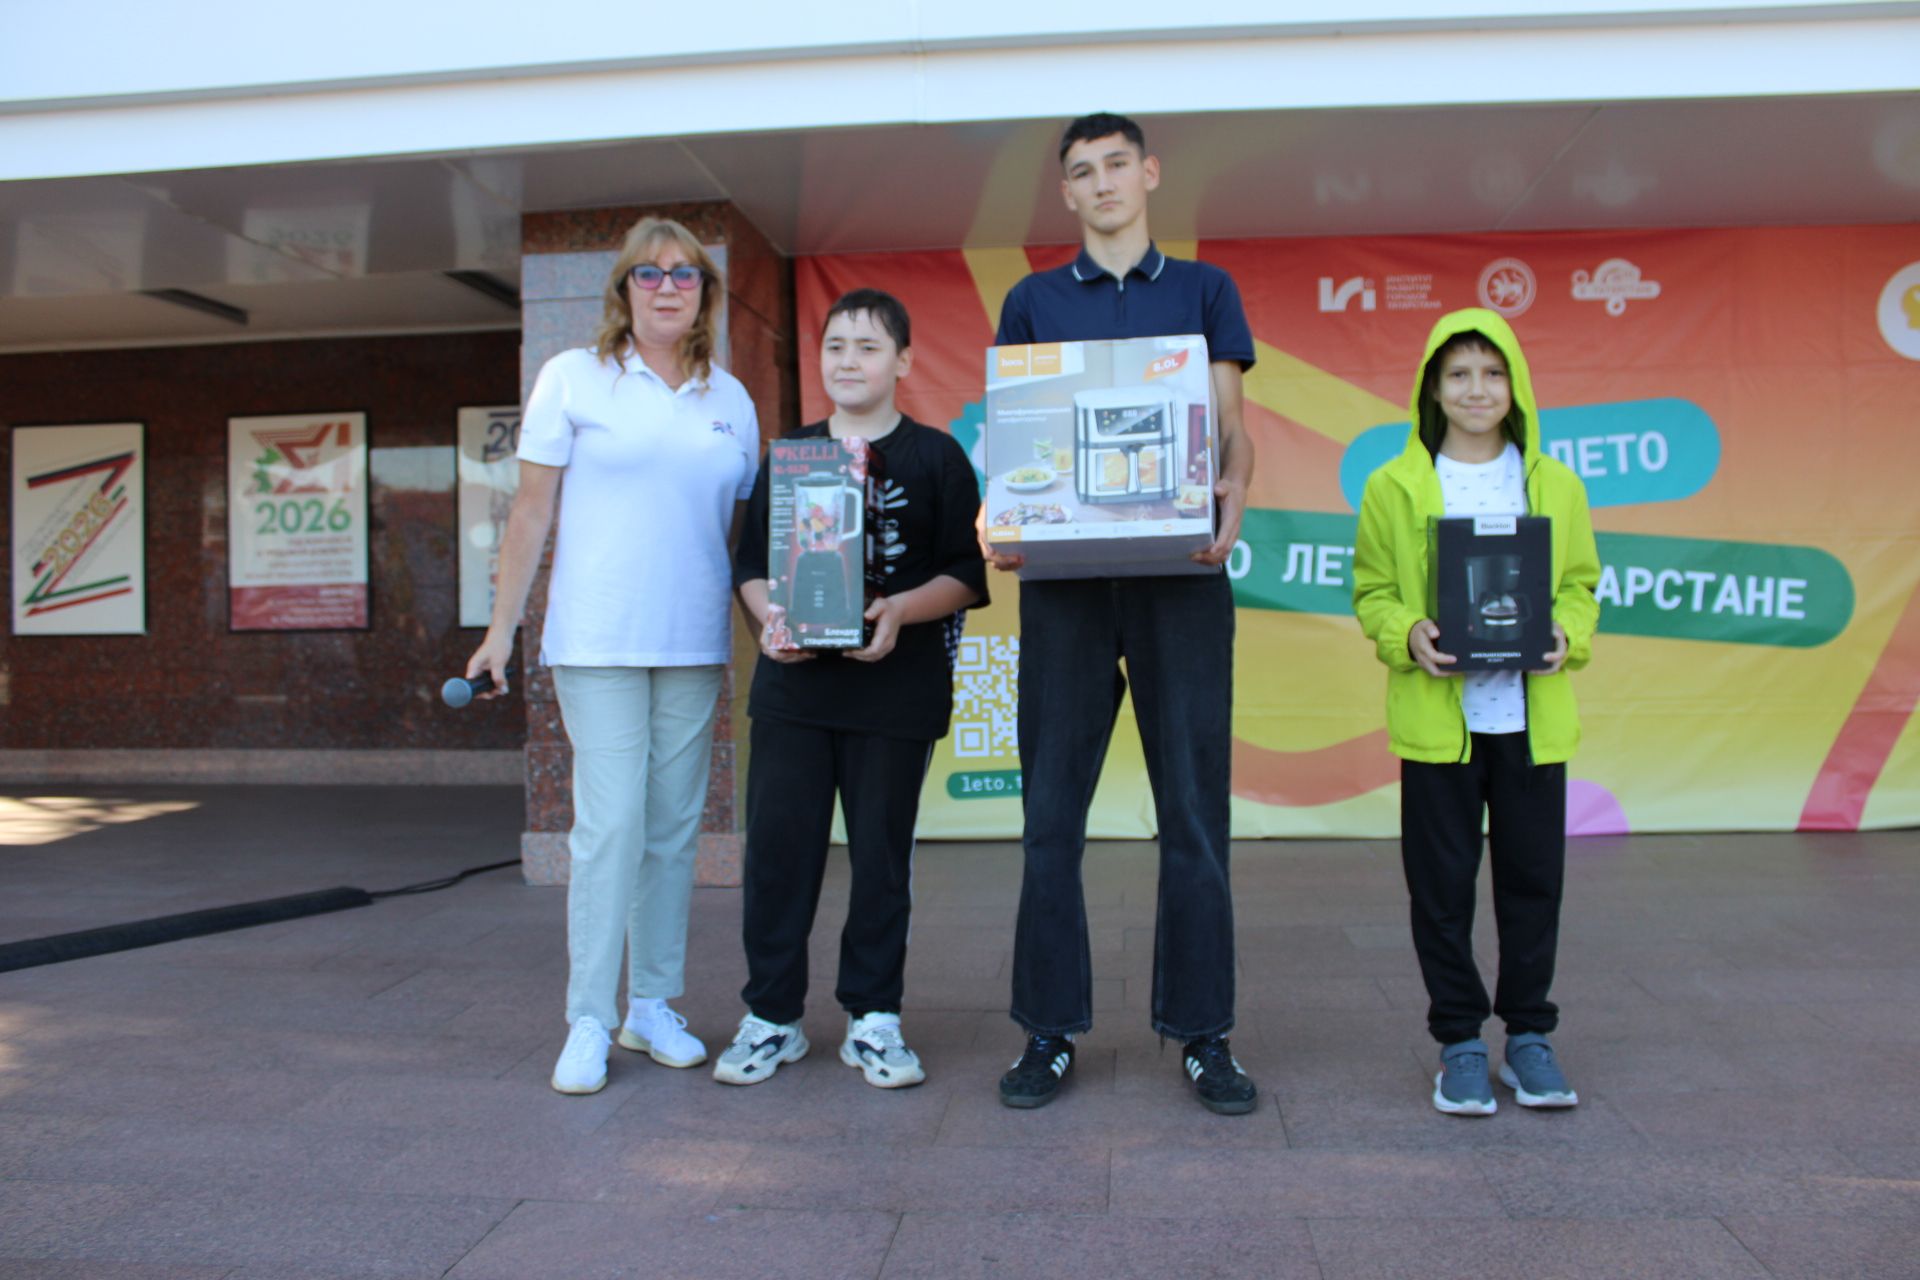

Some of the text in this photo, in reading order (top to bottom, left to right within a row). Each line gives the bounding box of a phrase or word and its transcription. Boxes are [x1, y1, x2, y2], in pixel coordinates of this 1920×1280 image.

[255, 497, 351, 535] 2026
[1281, 542, 1355, 586] ЛЕ
[1594, 564, 1808, 620] АРСТАНЕ
